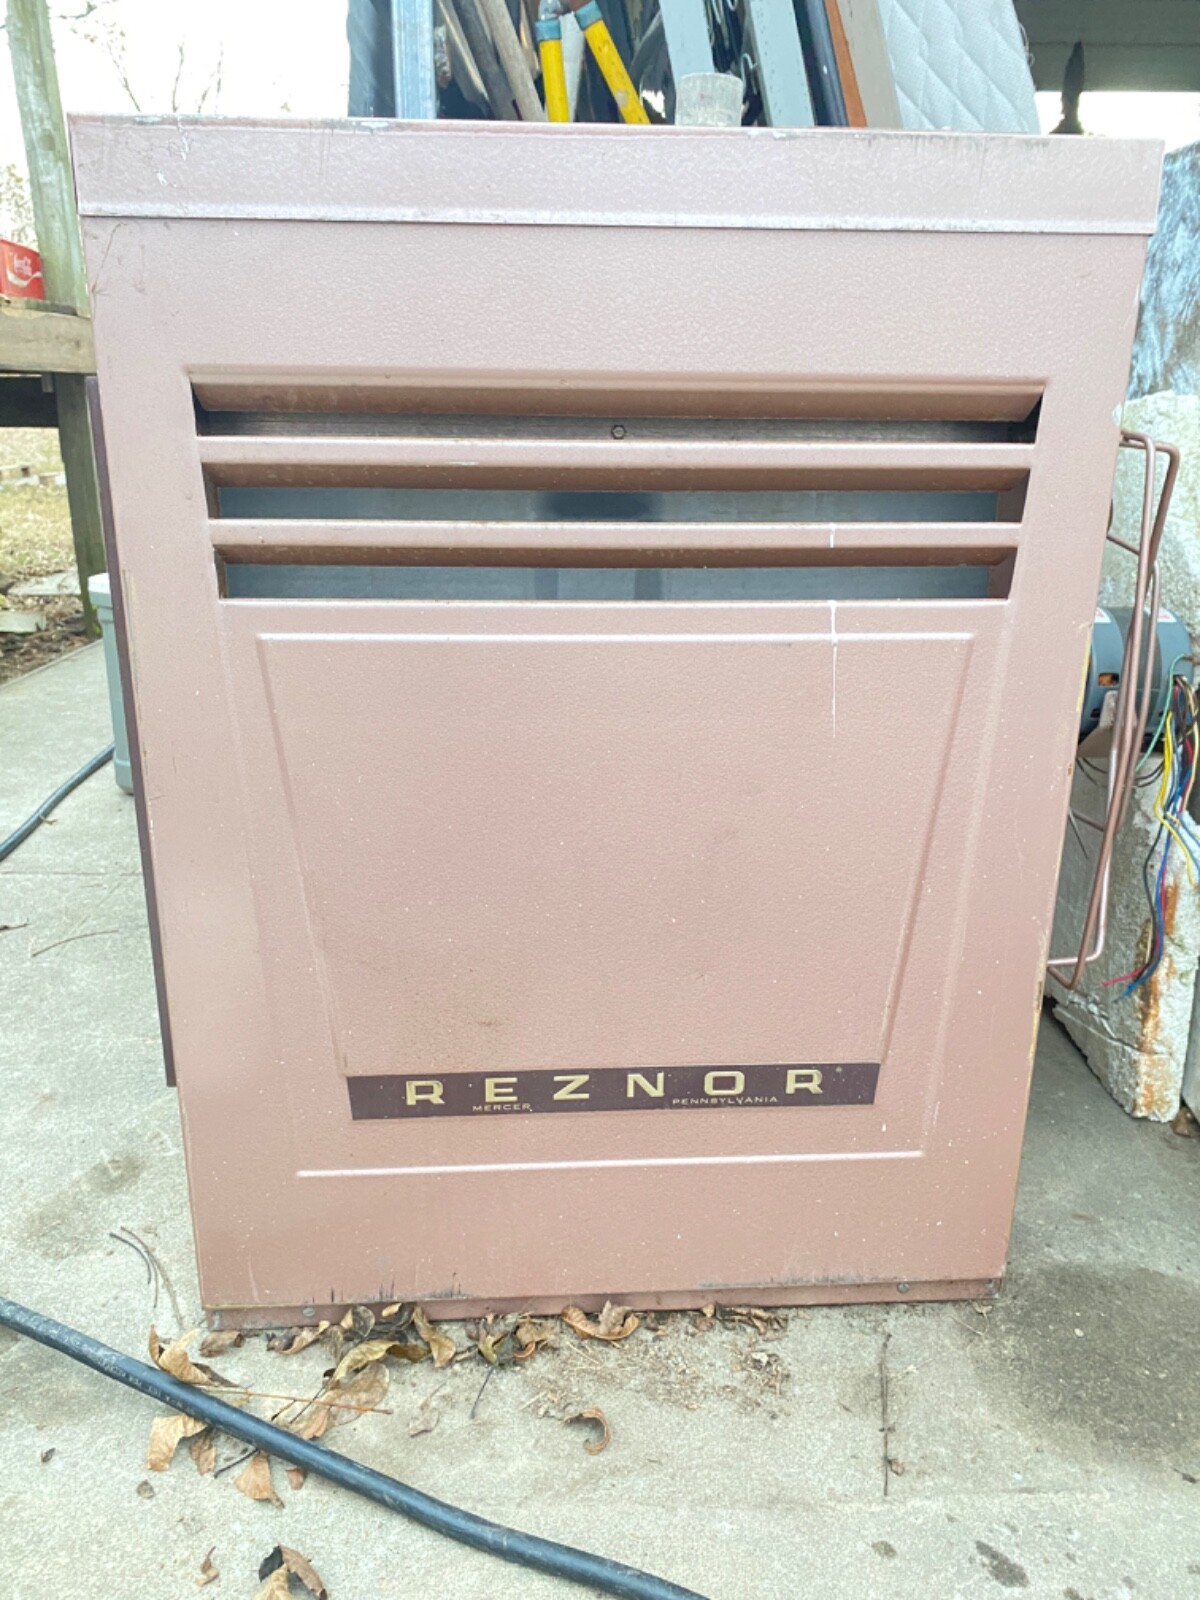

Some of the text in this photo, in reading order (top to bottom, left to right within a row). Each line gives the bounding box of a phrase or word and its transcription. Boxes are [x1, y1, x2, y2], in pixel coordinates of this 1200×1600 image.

[405, 1069, 823, 1106] REZNOR
[472, 1096, 778, 1112] MERCER PENNSYLVANIA
